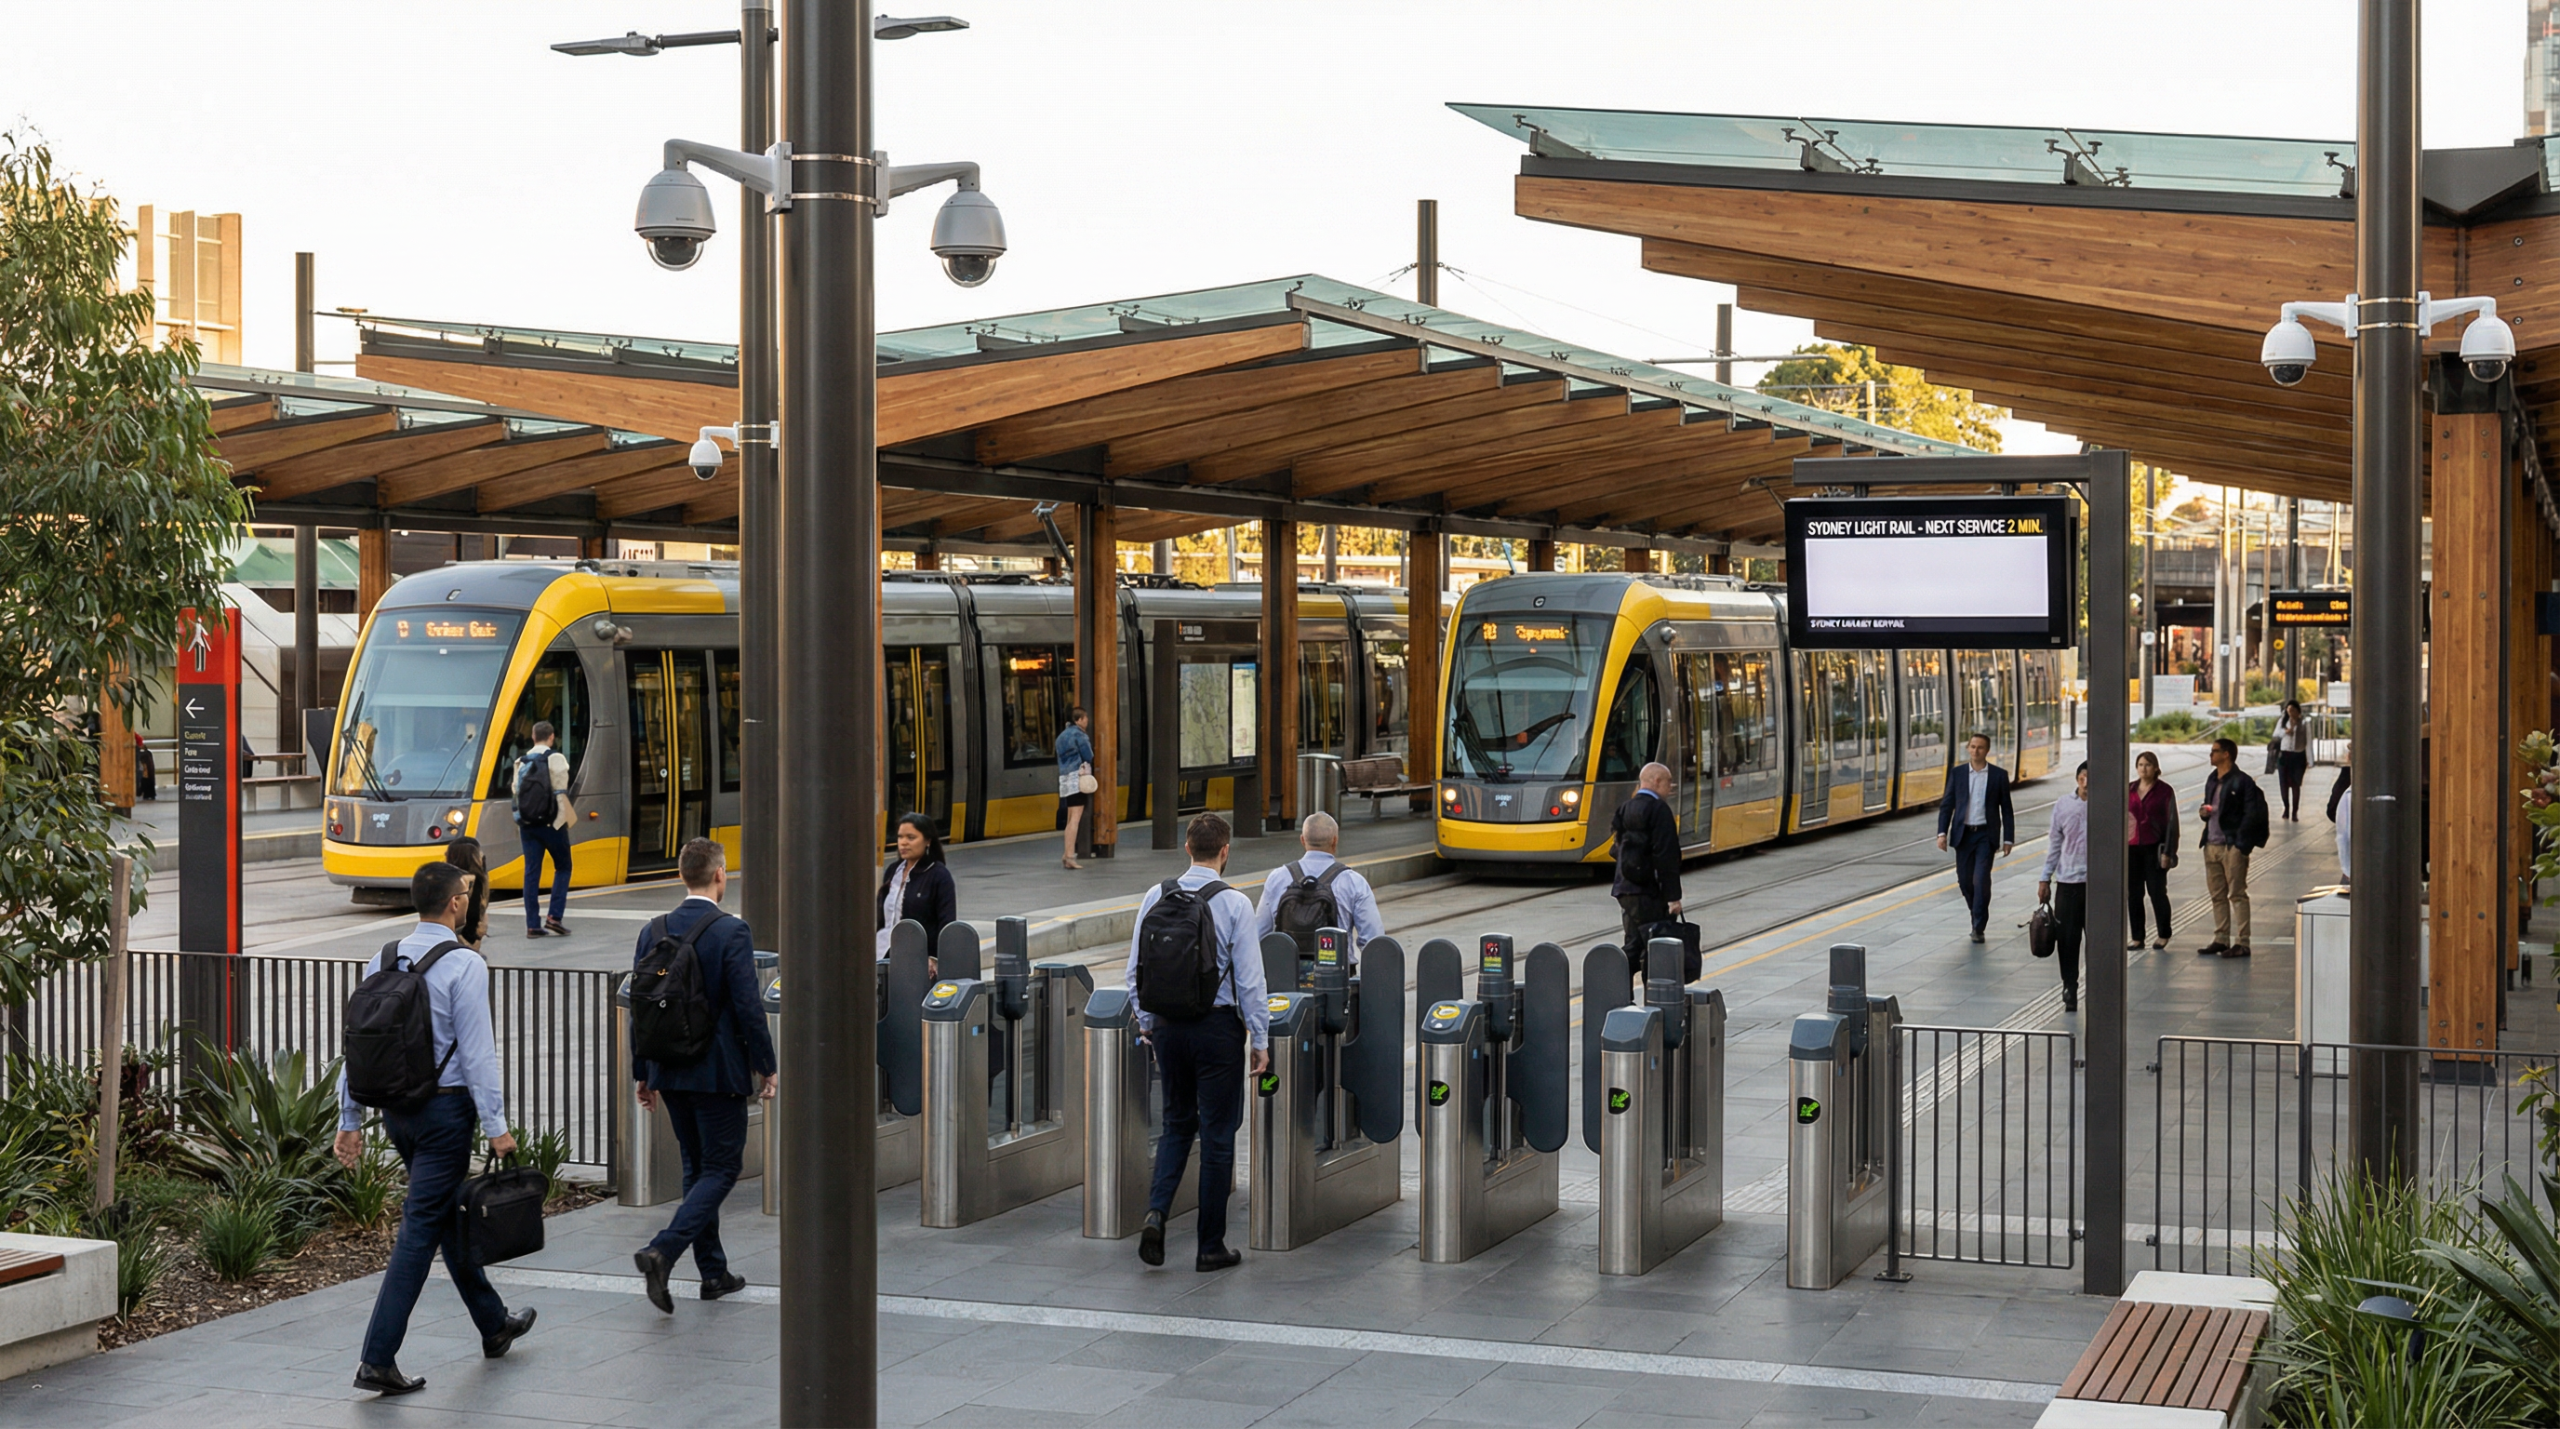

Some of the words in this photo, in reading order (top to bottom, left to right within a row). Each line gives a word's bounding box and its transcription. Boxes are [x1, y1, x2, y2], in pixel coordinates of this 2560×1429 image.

[1807, 521, 1852, 535] SYDNEY
[1854, 520, 1887, 535] LIGHT
[1889, 520, 1916, 534] RAIL
[1925, 520, 1955, 534] NEXT
[1957, 519, 2006, 534] SERVICE
[2007, 519, 2016, 533] 2
[2018, 519, 2043, 533] MIN.
